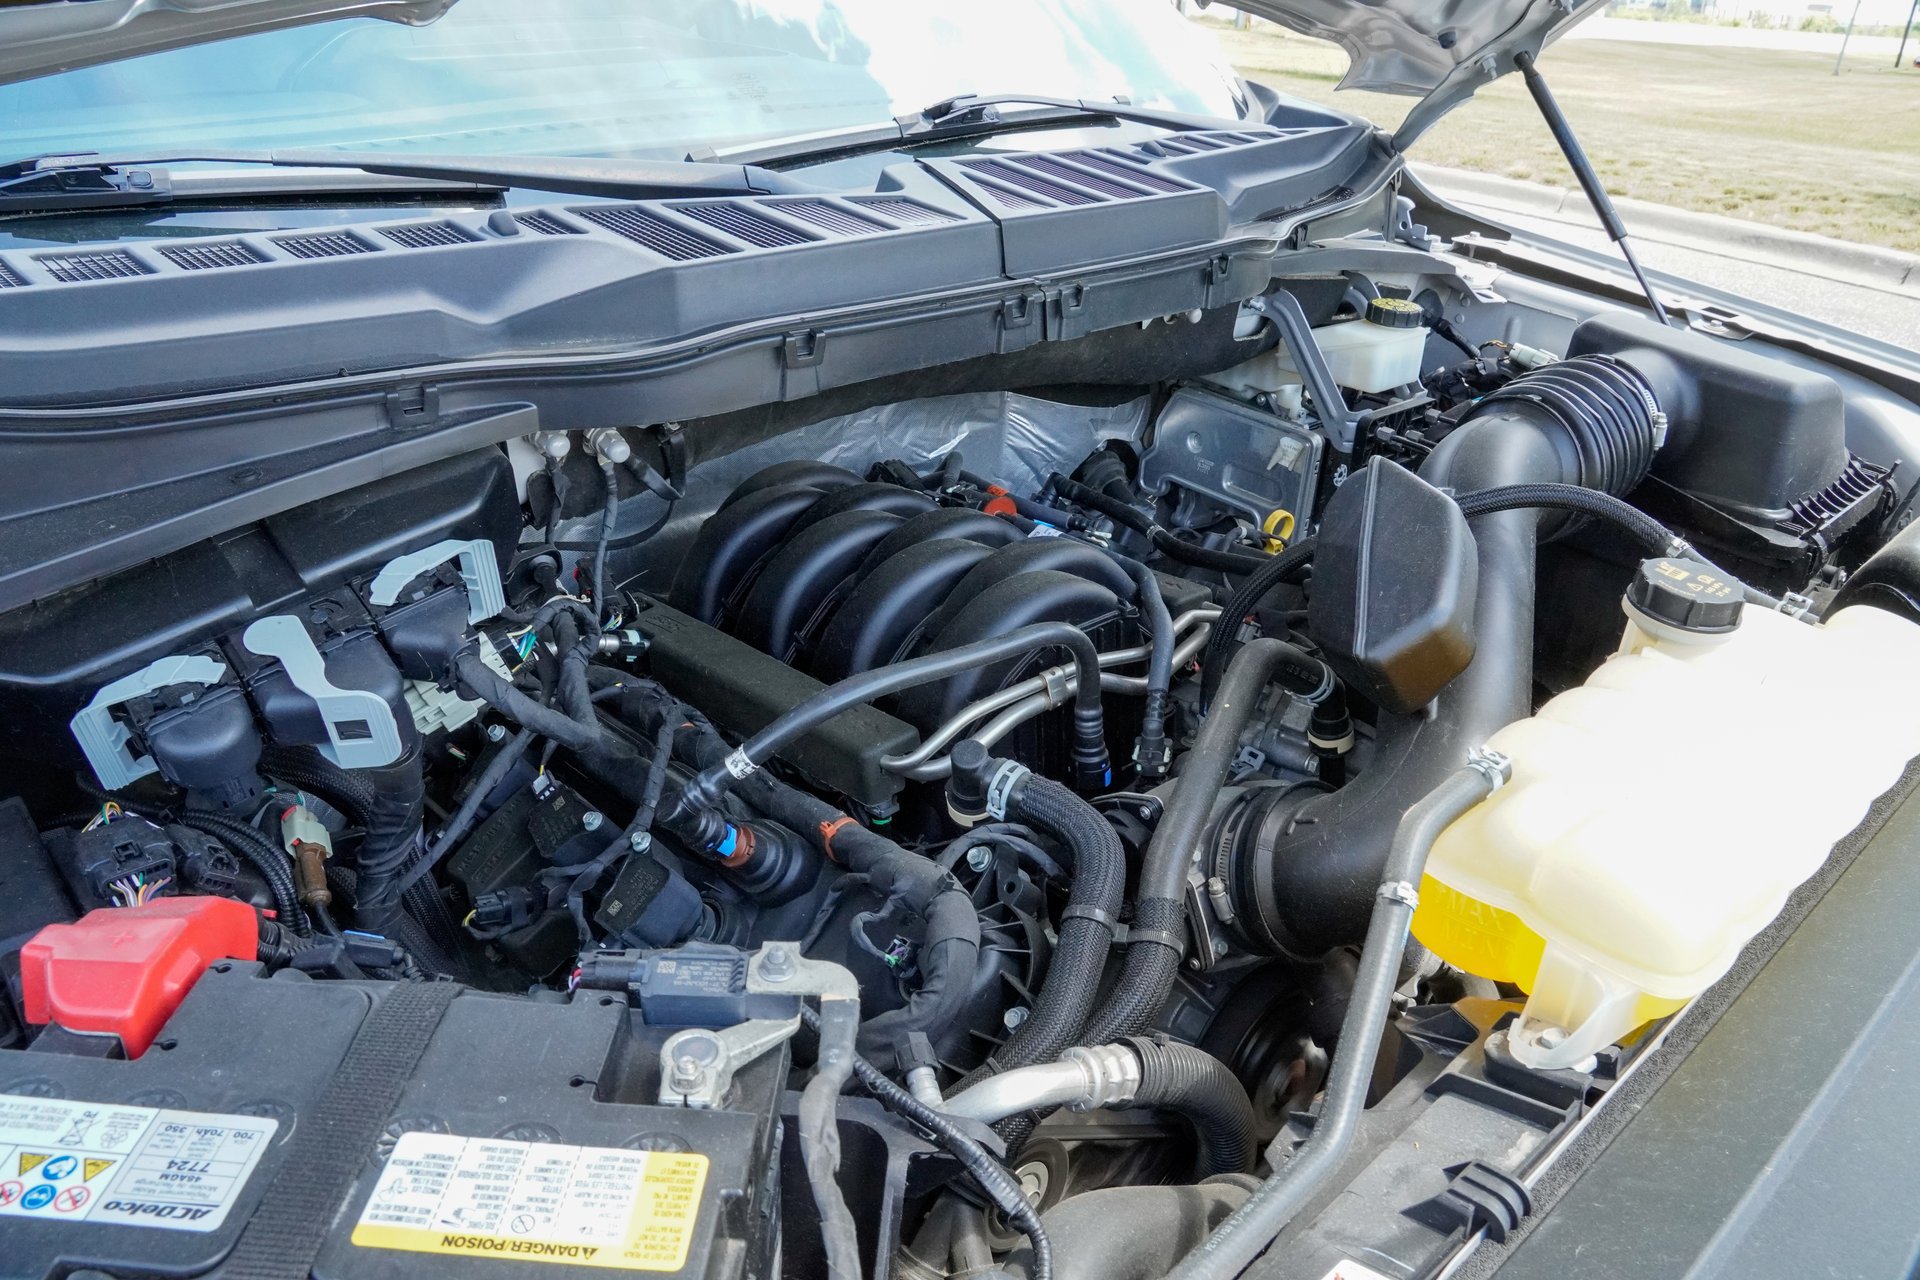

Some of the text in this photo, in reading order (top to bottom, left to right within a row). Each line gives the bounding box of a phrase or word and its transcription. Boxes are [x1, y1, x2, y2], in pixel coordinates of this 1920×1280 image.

[163, 1125, 187, 1133] 350
[193, 1128, 225, 1137] 70Ah
[232, 1131, 255, 1139] 700
[164, 1159, 212, 1172] 7724
[102, 1201, 212, 1221] ACDelco
[441, 1235, 579, 1258] DANGER/POISON
